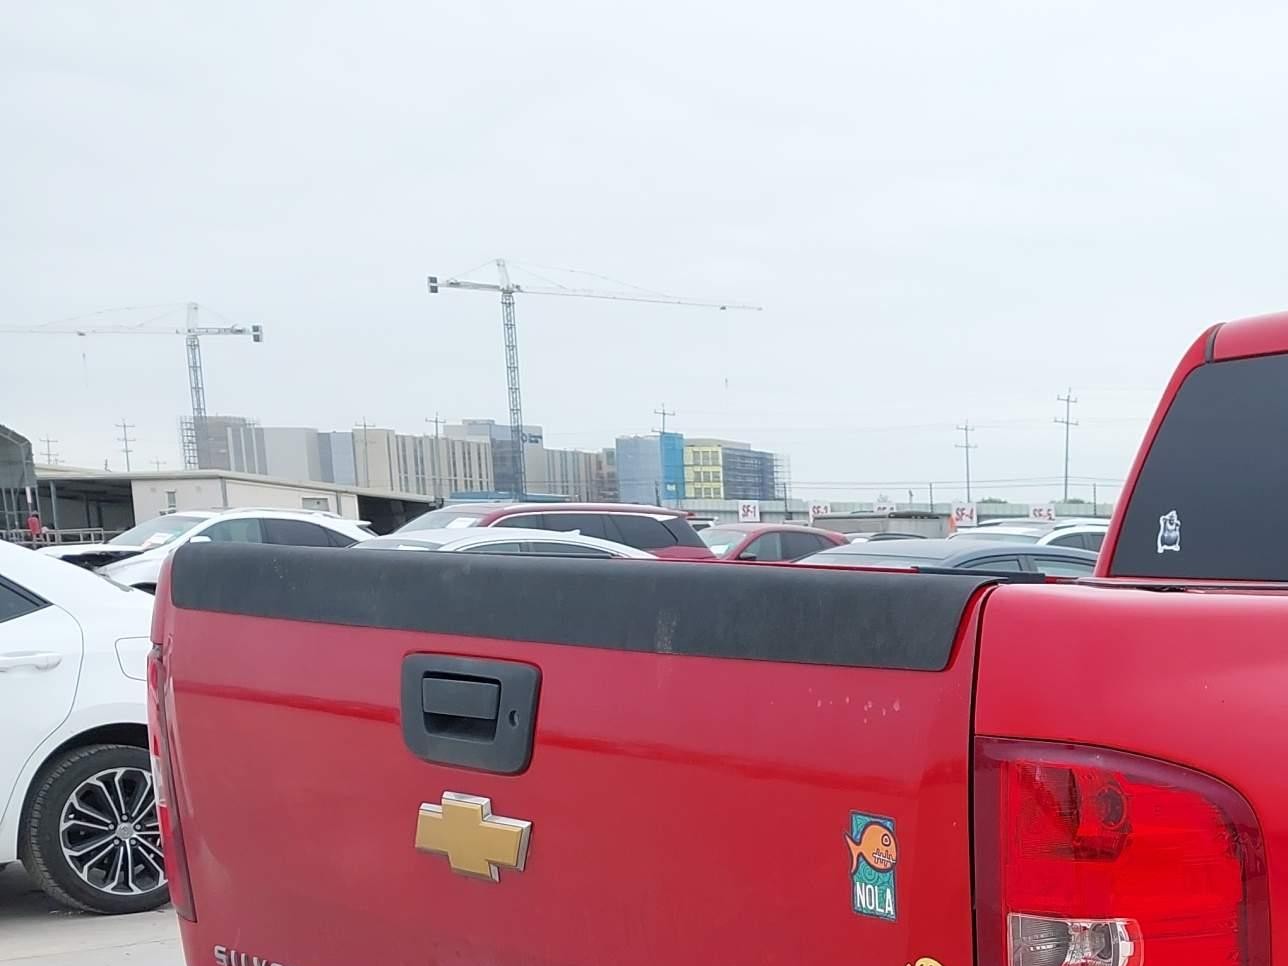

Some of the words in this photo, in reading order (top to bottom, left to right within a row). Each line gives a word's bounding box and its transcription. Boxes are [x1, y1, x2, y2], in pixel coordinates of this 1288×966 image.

[741, 503, 757, 518] SF-1
[954, 507, 974, 521] SF-4
[855, 881, 894, 915] NOLA
